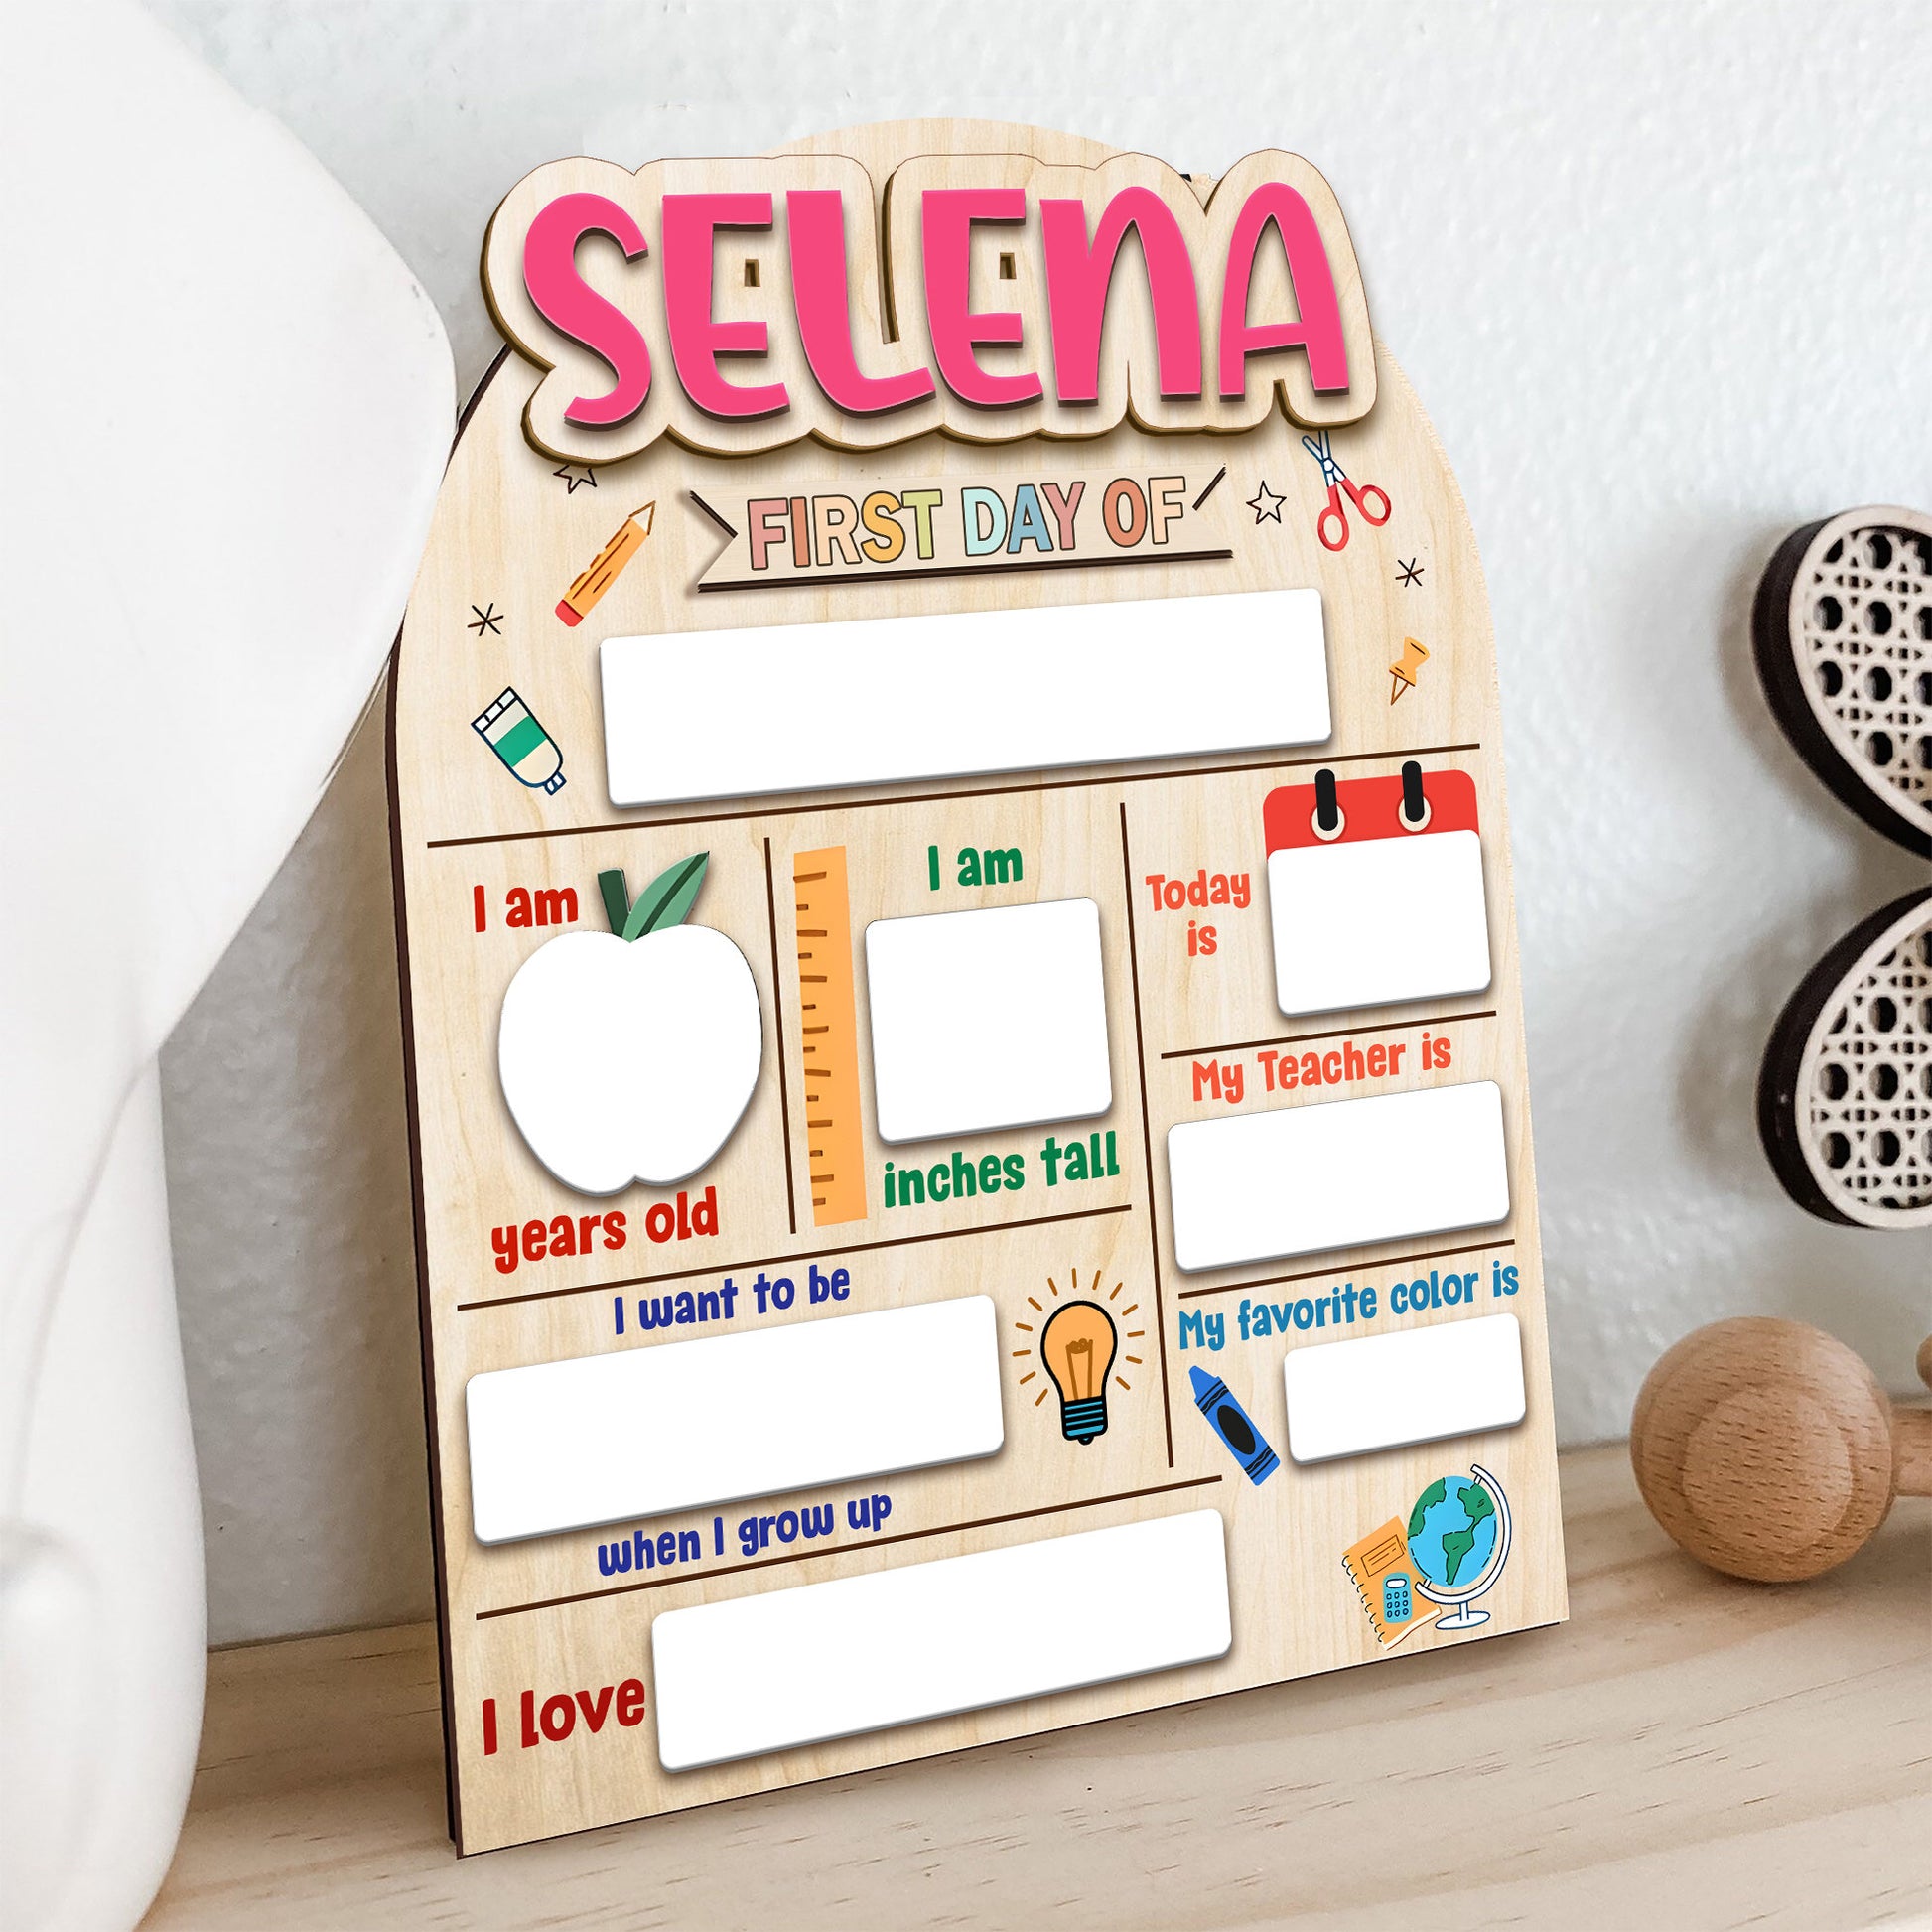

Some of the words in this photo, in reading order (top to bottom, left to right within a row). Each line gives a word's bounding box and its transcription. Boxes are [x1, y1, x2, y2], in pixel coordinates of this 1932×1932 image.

[523, 182, 1349, 423] SELENA
[747, 488, 943, 571] FIRST
[961, 482, 1086, 556] DAY
[1102, 476, 1186, 548] OF
[928, 845, 940, 891] I
[957, 847, 1024, 887] am
[1145, 869, 1251, 912] Today
[473, 885, 486, 933] I
[505, 887, 579, 928] am
[1187, 919, 1218, 957] is
[1192, 1058, 1244, 1104] My
[1257, 1040, 1406, 1092] Teacher
[1421, 1032, 1451, 1071] is
[884, 1151, 1026, 1208] inches
[1039, 1130, 1121, 1187] tall
[491, 1210, 627, 1274] years
[645, 1185, 719, 1244] old
[615, 1297, 624, 1335] I
[638, 1278, 738, 1330] want
[753, 1273, 795, 1313] to
[809, 1264, 850, 1304] be
[1178, 1309, 1225, 1352] My
[1237, 1283, 1377, 1341] favorite
[1390, 1270, 1479, 1315] color
[1492, 1260, 1519, 1298] is
[598, 1530, 701, 1576] when
[714, 1516, 724, 1556] I
[738, 1504, 834, 1557] grow
[847, 1494, 892, 1532] up
[482, 1698, 498, 1756] I
[520, 1678, 645, 1749] love
